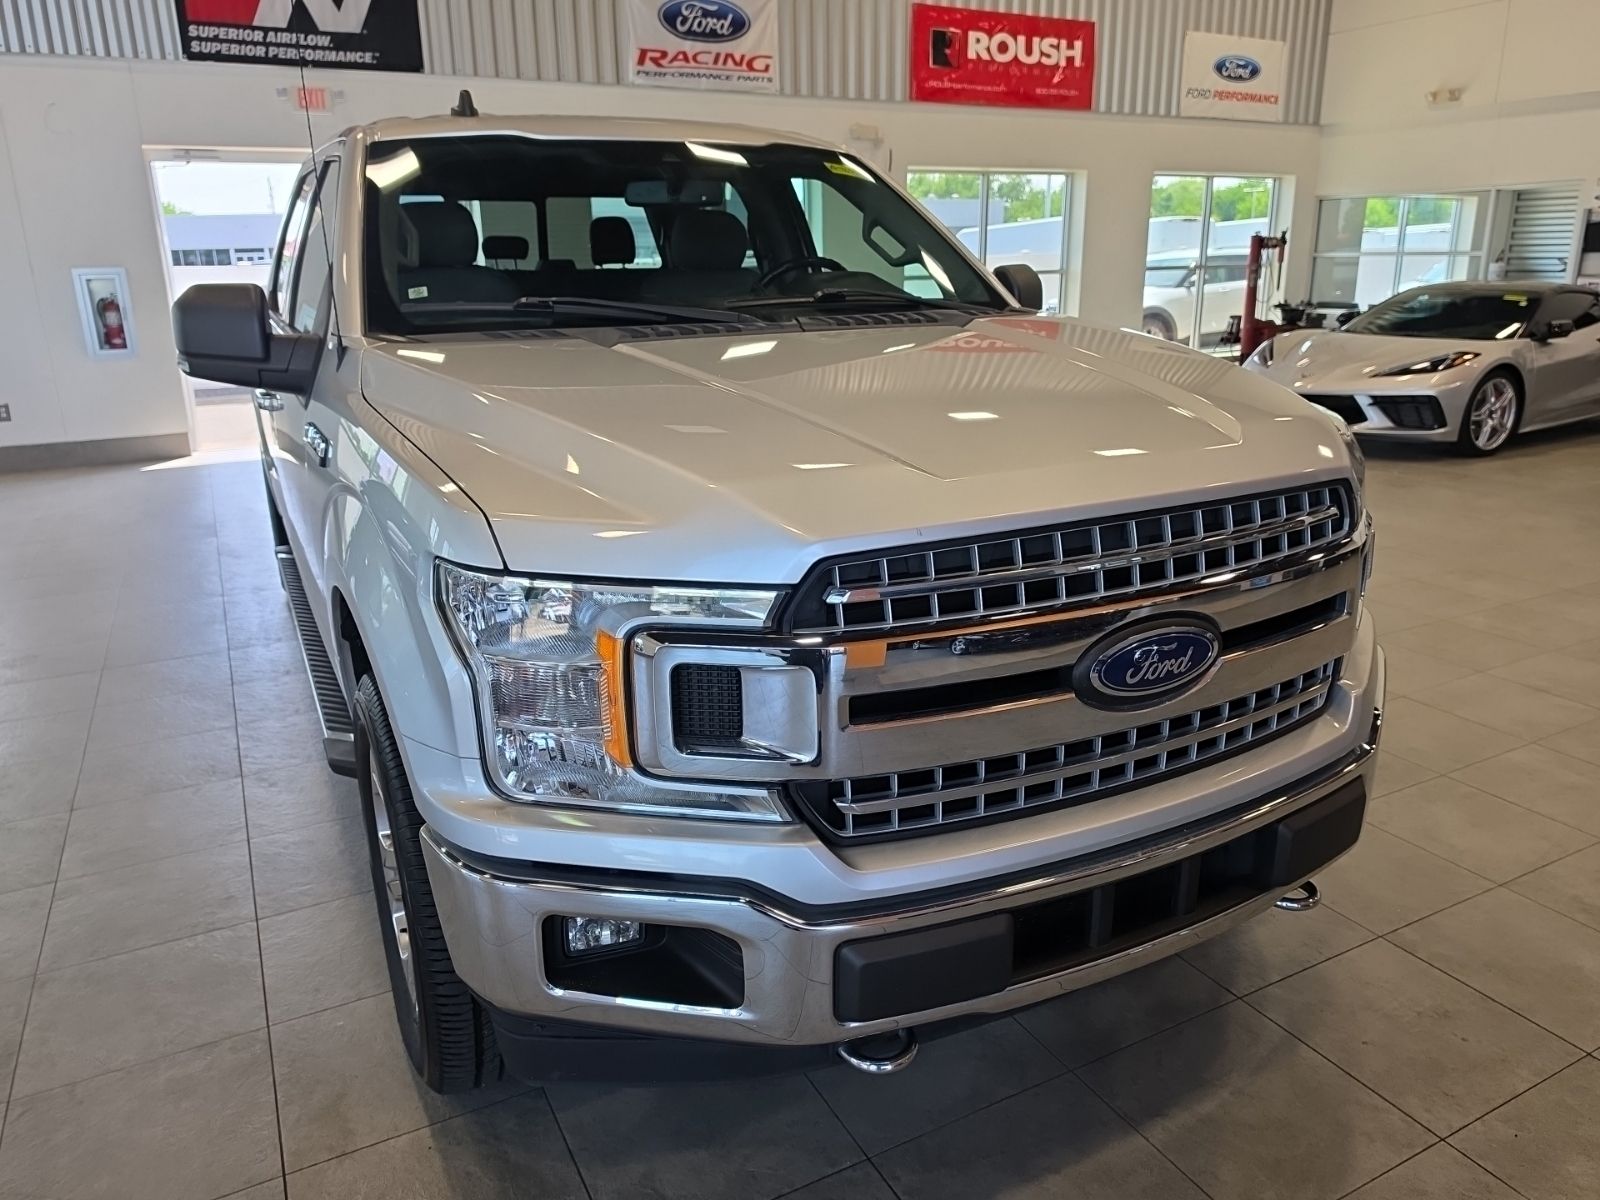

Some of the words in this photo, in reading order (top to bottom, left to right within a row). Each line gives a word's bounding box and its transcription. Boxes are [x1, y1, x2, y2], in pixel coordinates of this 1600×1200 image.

[675, 1, 734, 36] Ford
[188, 24, 263, 42] SUPERIOR
[266, 31, 333, 47] AIRFLOW.
[190, 40, 267, 57] SUPERIOR
[967, 30, 1083, 67] ROUSH
[636, 48, 773, 73] RACING
[1221, 58, 1253, 80] Ford
[636, 70, 734, 82] PERFORMANCE
[737, 75, 774, 83] PARTS
[297, 87, 326, 110] EXIT
[1185, 88, 1212, 100] FORD
[1212, 90, 1280, 105] PERFORMANCE
[1125, 641, 1194, 685] Ford
